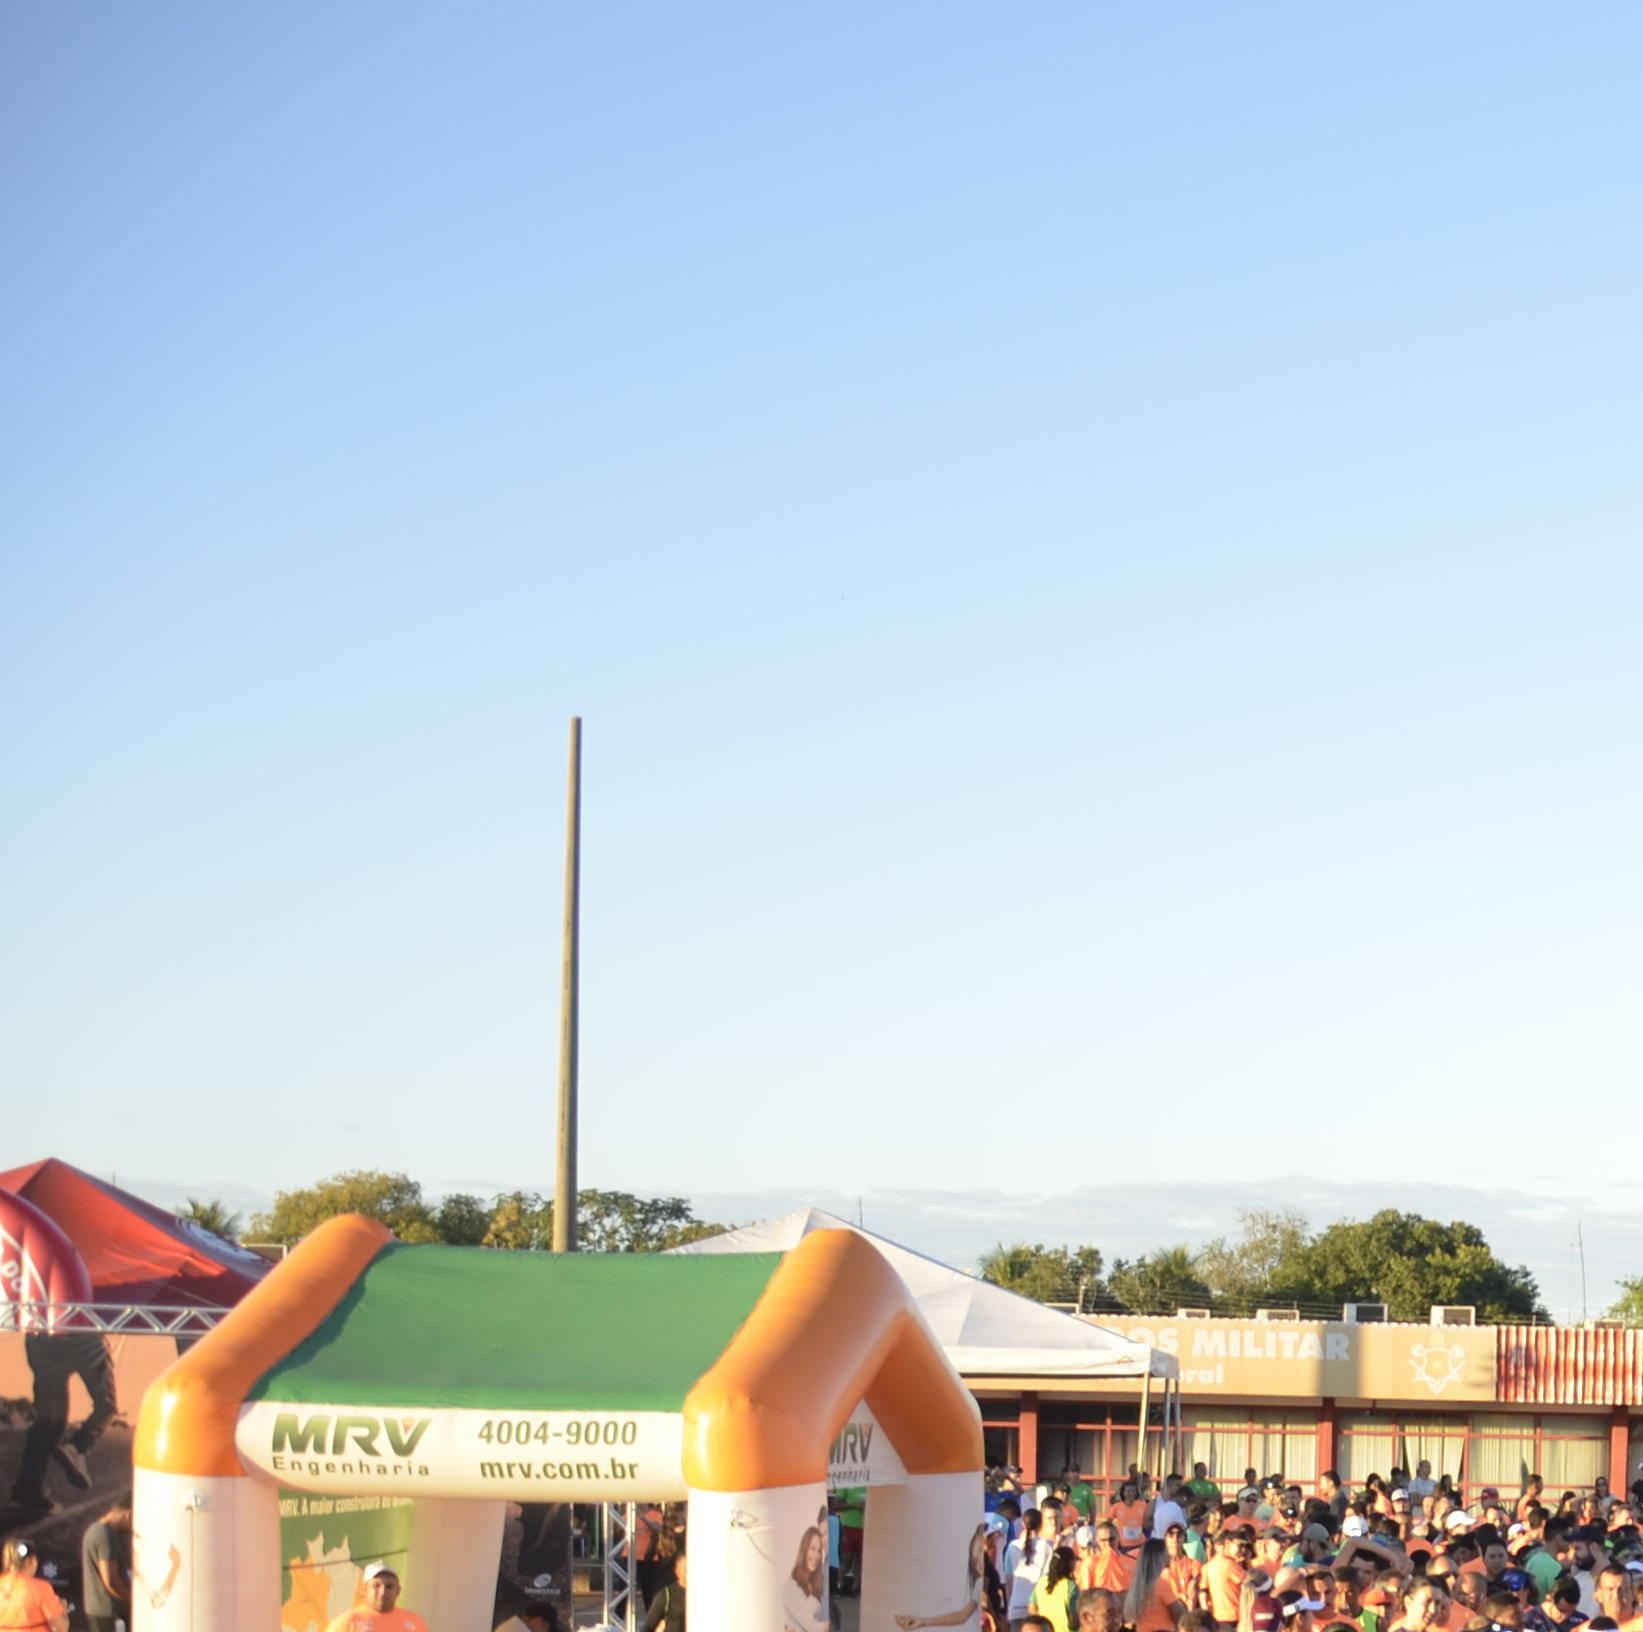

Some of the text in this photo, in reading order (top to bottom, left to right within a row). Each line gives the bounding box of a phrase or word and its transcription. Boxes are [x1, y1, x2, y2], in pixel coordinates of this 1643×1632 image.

[1192, 1328, 1350, 1361] MILITAR
[272, 1413, 433, 1458] MRV
[478, 1419, 639, 1447] 4004-9000
[272, 1455, 430, 1478] Engenharia
[478, 1457, 640, 1481] mrv.com.br
